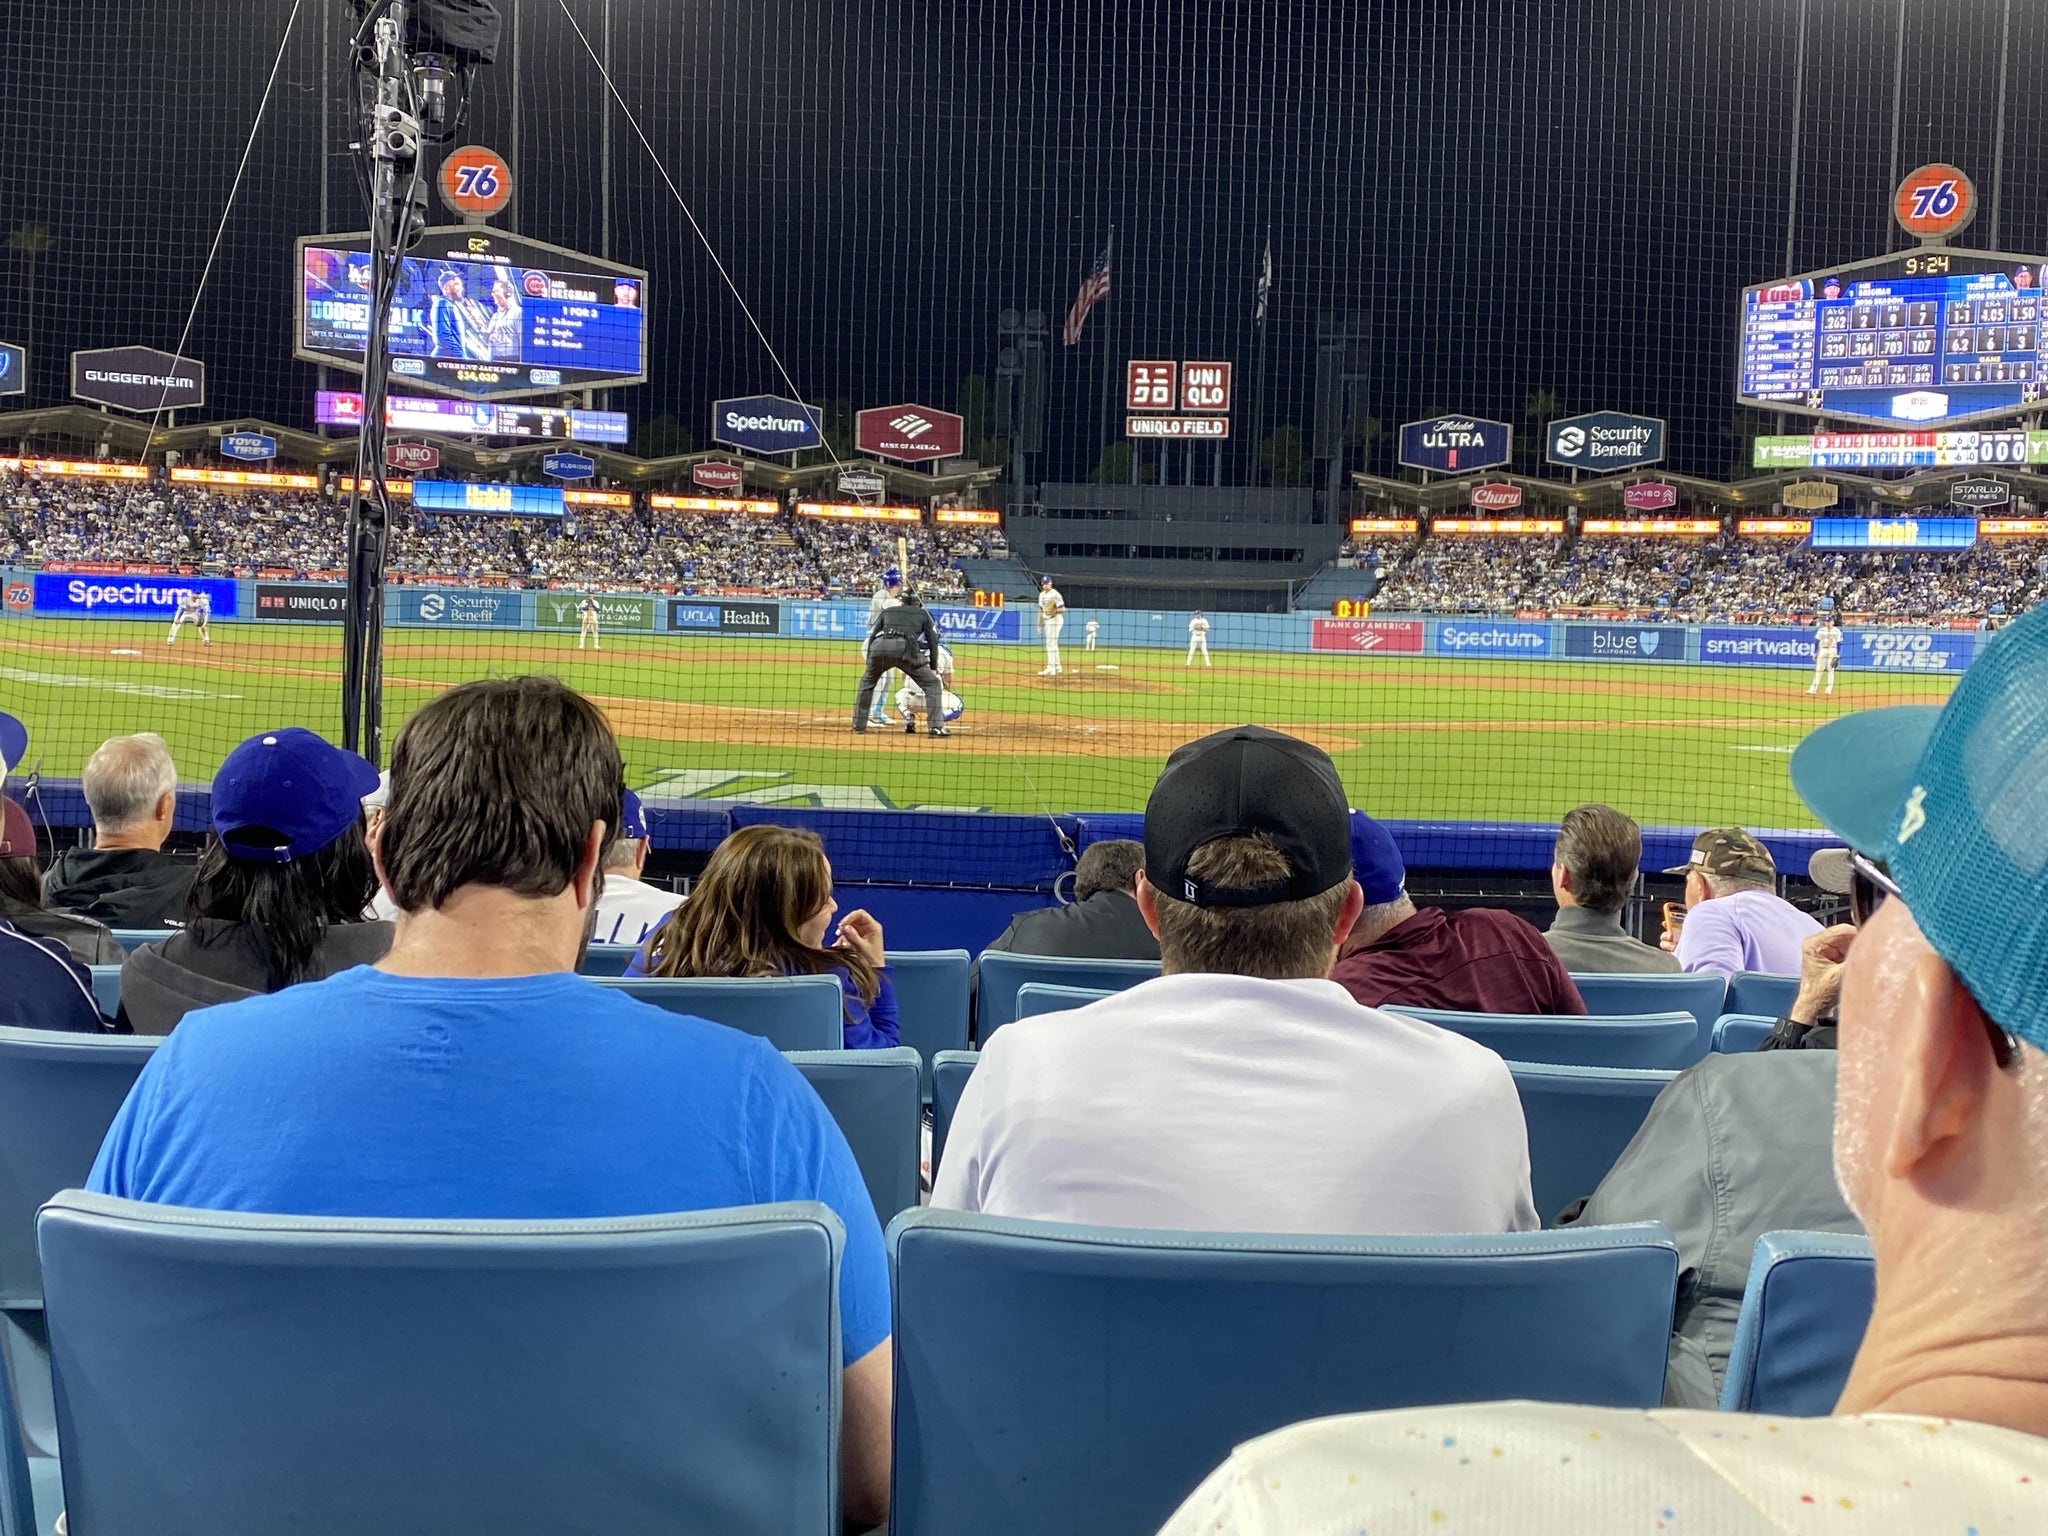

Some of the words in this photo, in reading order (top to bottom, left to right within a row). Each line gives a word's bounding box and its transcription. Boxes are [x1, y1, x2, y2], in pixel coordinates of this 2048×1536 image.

[455, 164, 500, 198] 76
[1909, 180, 1960, 219] 76
[1906, 256, 1949, 274] 9:24
[570, 307, 589, 318] FOR
[1954, 310, 1970, 323] 1-1
[2013, 306, 2036, 320] 1.50
[1825, 316, 1846, 330] .262
[1860, 315, 1868, 328] 2
[1890, 314, 1897, 326] 9
[1919, 312, 1926, 324] 7
[1823, 344, 1845, 357] .339
[1880, 341, 1903, 354] .703
[1912, 340, 1932, 353] 107
[1952, 338, 1968, 352] 6.2
[1987, 337, 1994, 350] 6
[2018, 336, 2026, 349] 3
[85, 370, 194, 388] GUGGENHEIM
[1188, 368, 1222, 386] UNI
[1822, 376, 1839, 386] .272
[1891, 374, 1906, 384] 734
[1188, 386, 1224, 406] QLO
[726, 411, 806, 433] Spectrum
[228, 437, 262, 446] TOYO
[1423, 432, 1485, 448] ULTRA
[1590, 426, 1652, 442] Security
[232, 445, 270, 456] TIRES
[395, 447, 431, 462] JINRO
[1590, 442, 1643, 457] Benefit
[1980, 441, 1993, 462] 0
[1996, 441, 2008, 462] 0
[2012, 440, 2024, 461] 0
[560, 462, 592, 471] ELDRIDGE
[696, 468, 740, 480] Yakult
[1474, 489, 1520, 504] Churu
[1954, 485, 2006, 494] STARLUX
[1962, 492, 1998, 500] AIRLINES
[9, 588, 30, 602] 76
[68, 580, 193, 609] Spectrum
[975, 590, 1004, 608] 0:11
[289, 596, 338, 612] UNIQLO
[450, 595, 500, 612] Security
[574, 602, 642, 614] YMAVA'
[1336, 600, 1370, 618] 0:11
[451, 607, 495, 622] Benefit
[682, 611, 715, 623] UCLA
[723, 611, 770, 626] Health
[795, 609, 845, 631] TEL
[940, 612, 977, 629] ANA
[1324, 621, 1346, 630] BANK
[1348, 622, 1360, 630] OF
[1360, 622, 1412, 631] AMERICA
[1442, 628, 1538, 650] Spectrum
[1593, 630, 1638, 649] blue
[1860, 634, 1932, 652] TOYO
[1872, 650, 1950, 669] TIRES
